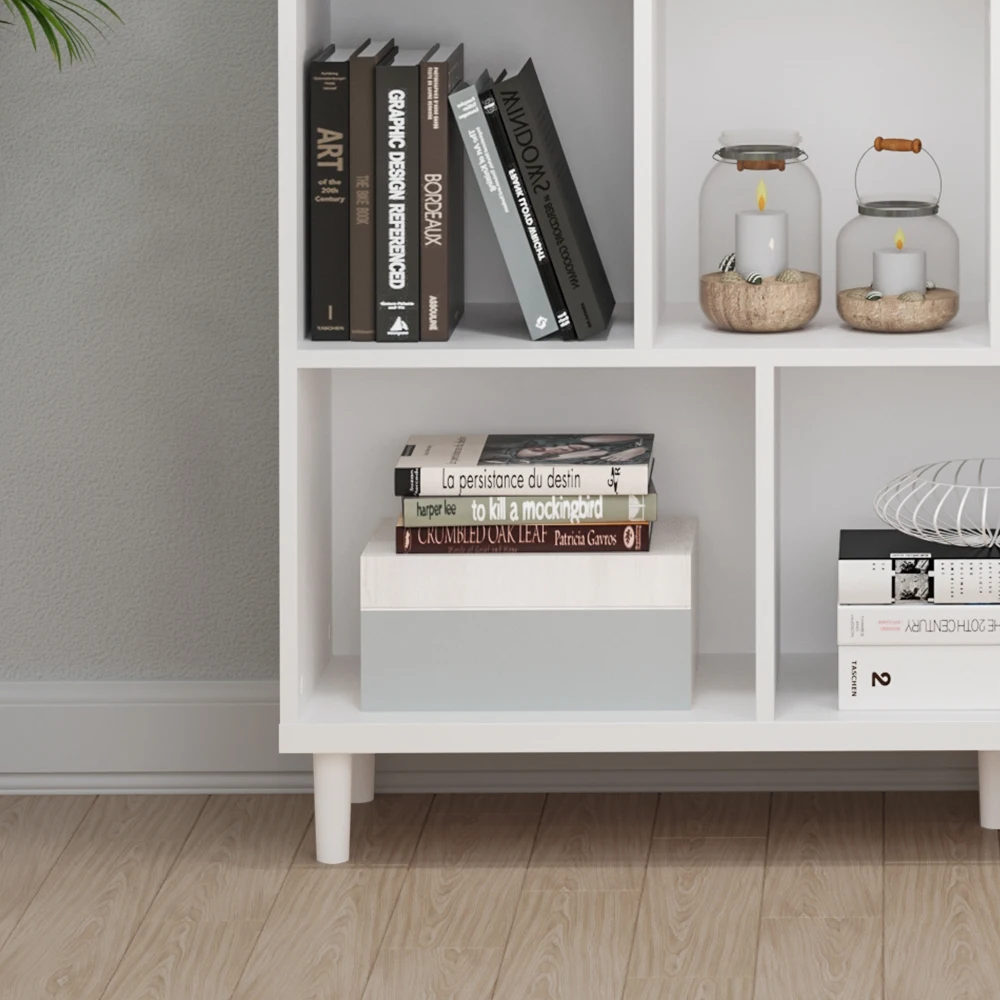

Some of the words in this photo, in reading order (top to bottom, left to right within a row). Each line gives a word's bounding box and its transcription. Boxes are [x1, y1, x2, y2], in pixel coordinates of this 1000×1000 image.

[388, 88, 406, 148] GRAPHIC
[316, 128, 344, 171] ART
[356, 175, 370, 188] THE
[388, 150, 406, 200] DESIGN
[424, 173, 442, 246] BORDEAUX
[388, 202, 406, 290] REFERENCED
[428, 295, 438, 332] ASSOULINE
[442, 469, 456, 489] La
[459, 470, 524, 495] persistance
[528, 468, 544, 488] du
[547, 468, 582, 488] destin
[416, 502, 442, 520] harper
[444, 500, 456, 516] lee
[472, 500, 486, 521] to
[489, 496, 506, 520] kill
[510, 504, 518, 520] a
[522, 495, 604, 523] mockingbird
[418, 525, 486, 544] CRUMBLED
[488, 525, 516, 544] OAK
[518, 524, 548, 543] LEAF
[554, 530, 586, 546] Patricia
[586, 528, 618, 548] Gavros
[904, 618, 956, 632] CENTURY
[956, 618, 986, 632] 20TH
[871, 672, 892, 687] 2
